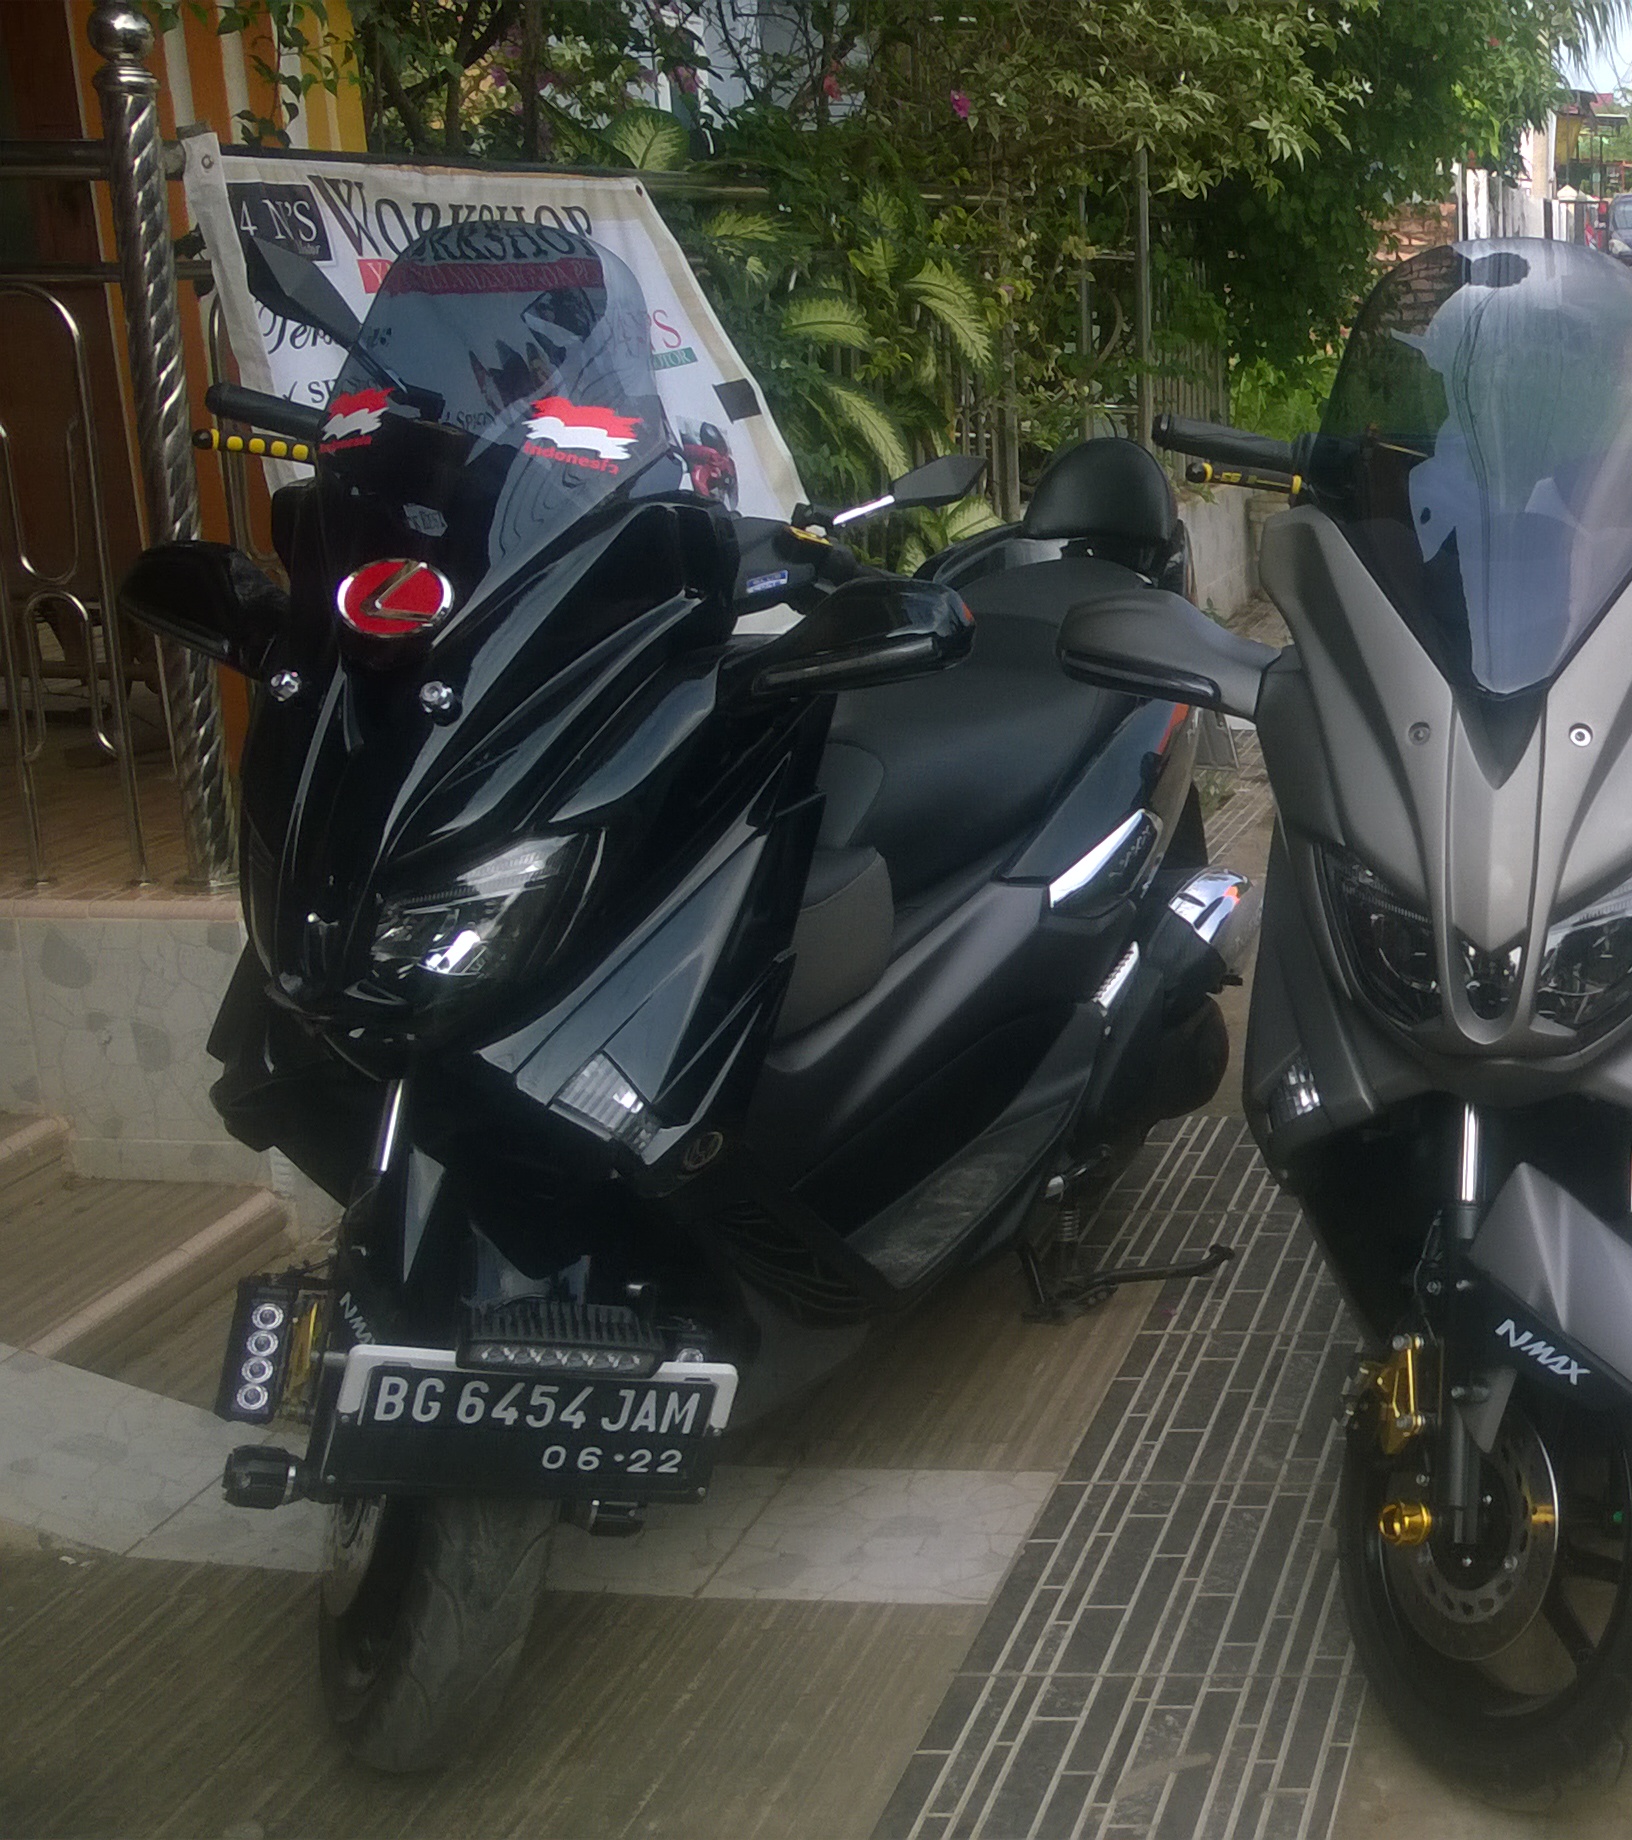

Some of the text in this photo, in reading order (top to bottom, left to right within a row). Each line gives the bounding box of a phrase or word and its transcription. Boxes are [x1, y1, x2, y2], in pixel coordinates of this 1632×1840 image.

[239, 199, 318, 243] 4 N'S
[306, 174, 602, 262] WORKSHOP
[523, 440, 619, 476] Indonesia
[1494, 1318, 1592, 1386] NMAX
[373, 1375, 701, 1435] BG 6454 JAM
